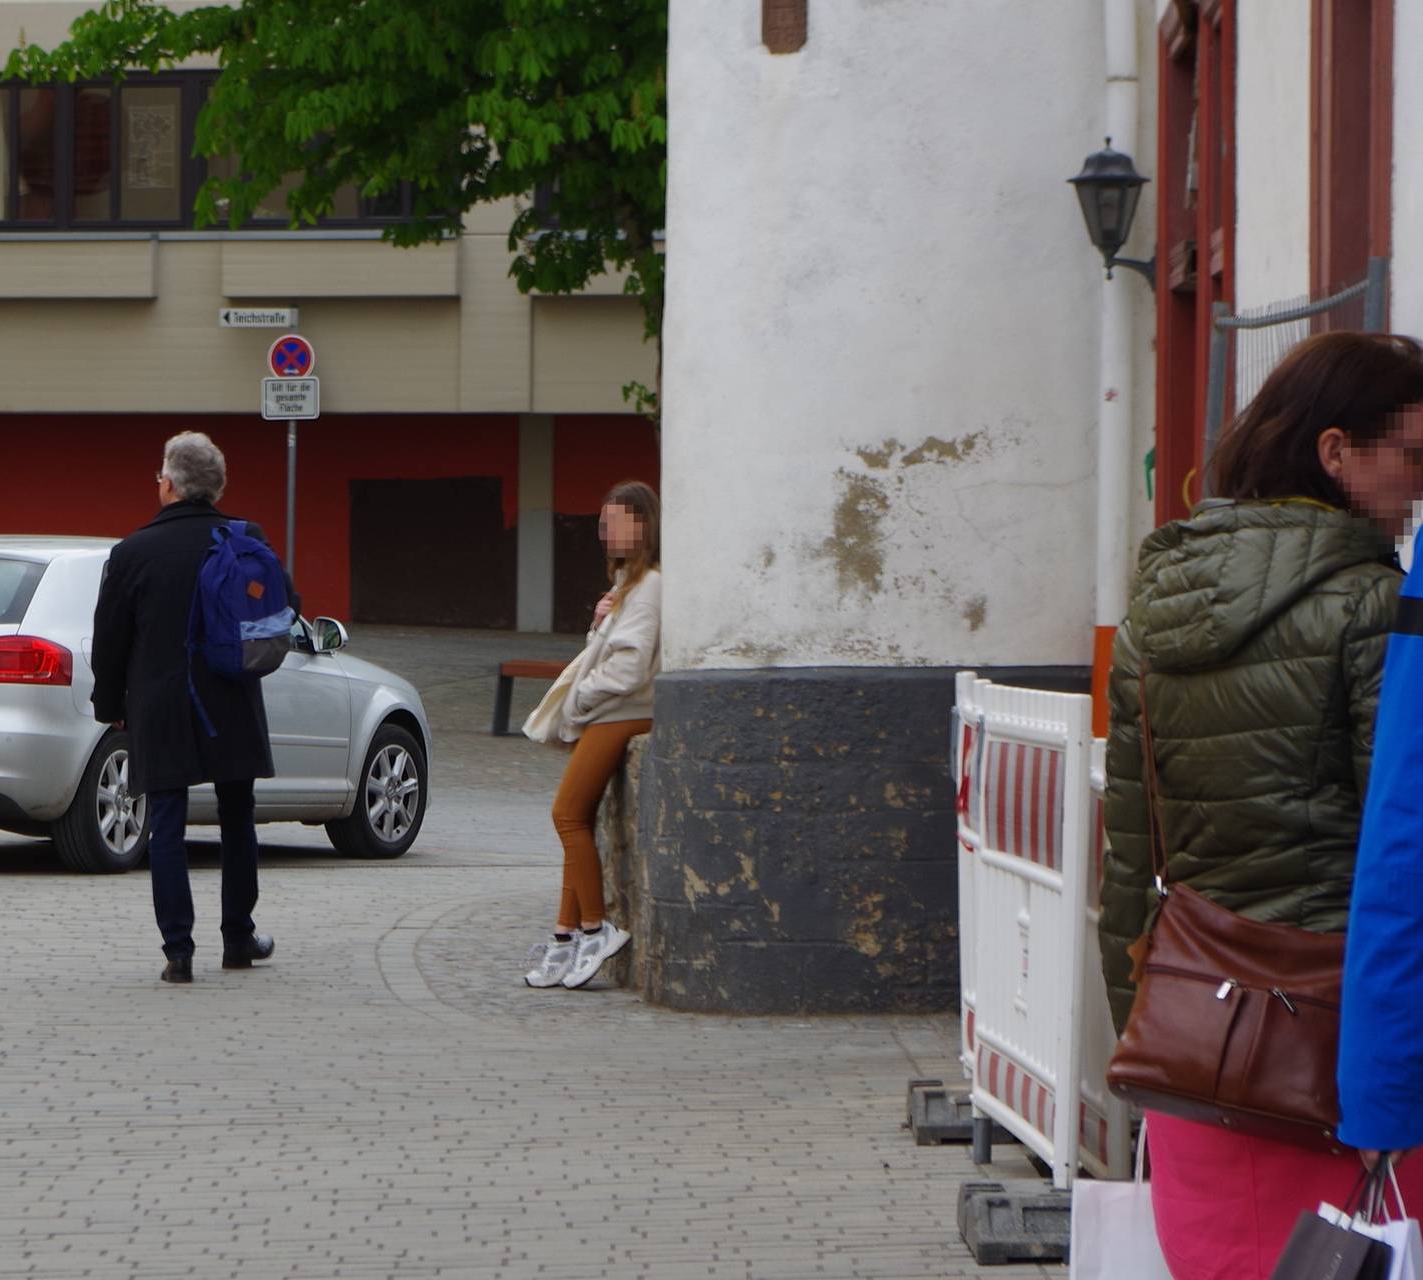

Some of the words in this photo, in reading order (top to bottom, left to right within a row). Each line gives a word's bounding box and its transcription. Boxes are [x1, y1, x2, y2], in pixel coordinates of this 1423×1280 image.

[271, 382, 283, 392] Gilt
[287, 382, 297, 392] für
[300, 382, 311, 392] die
